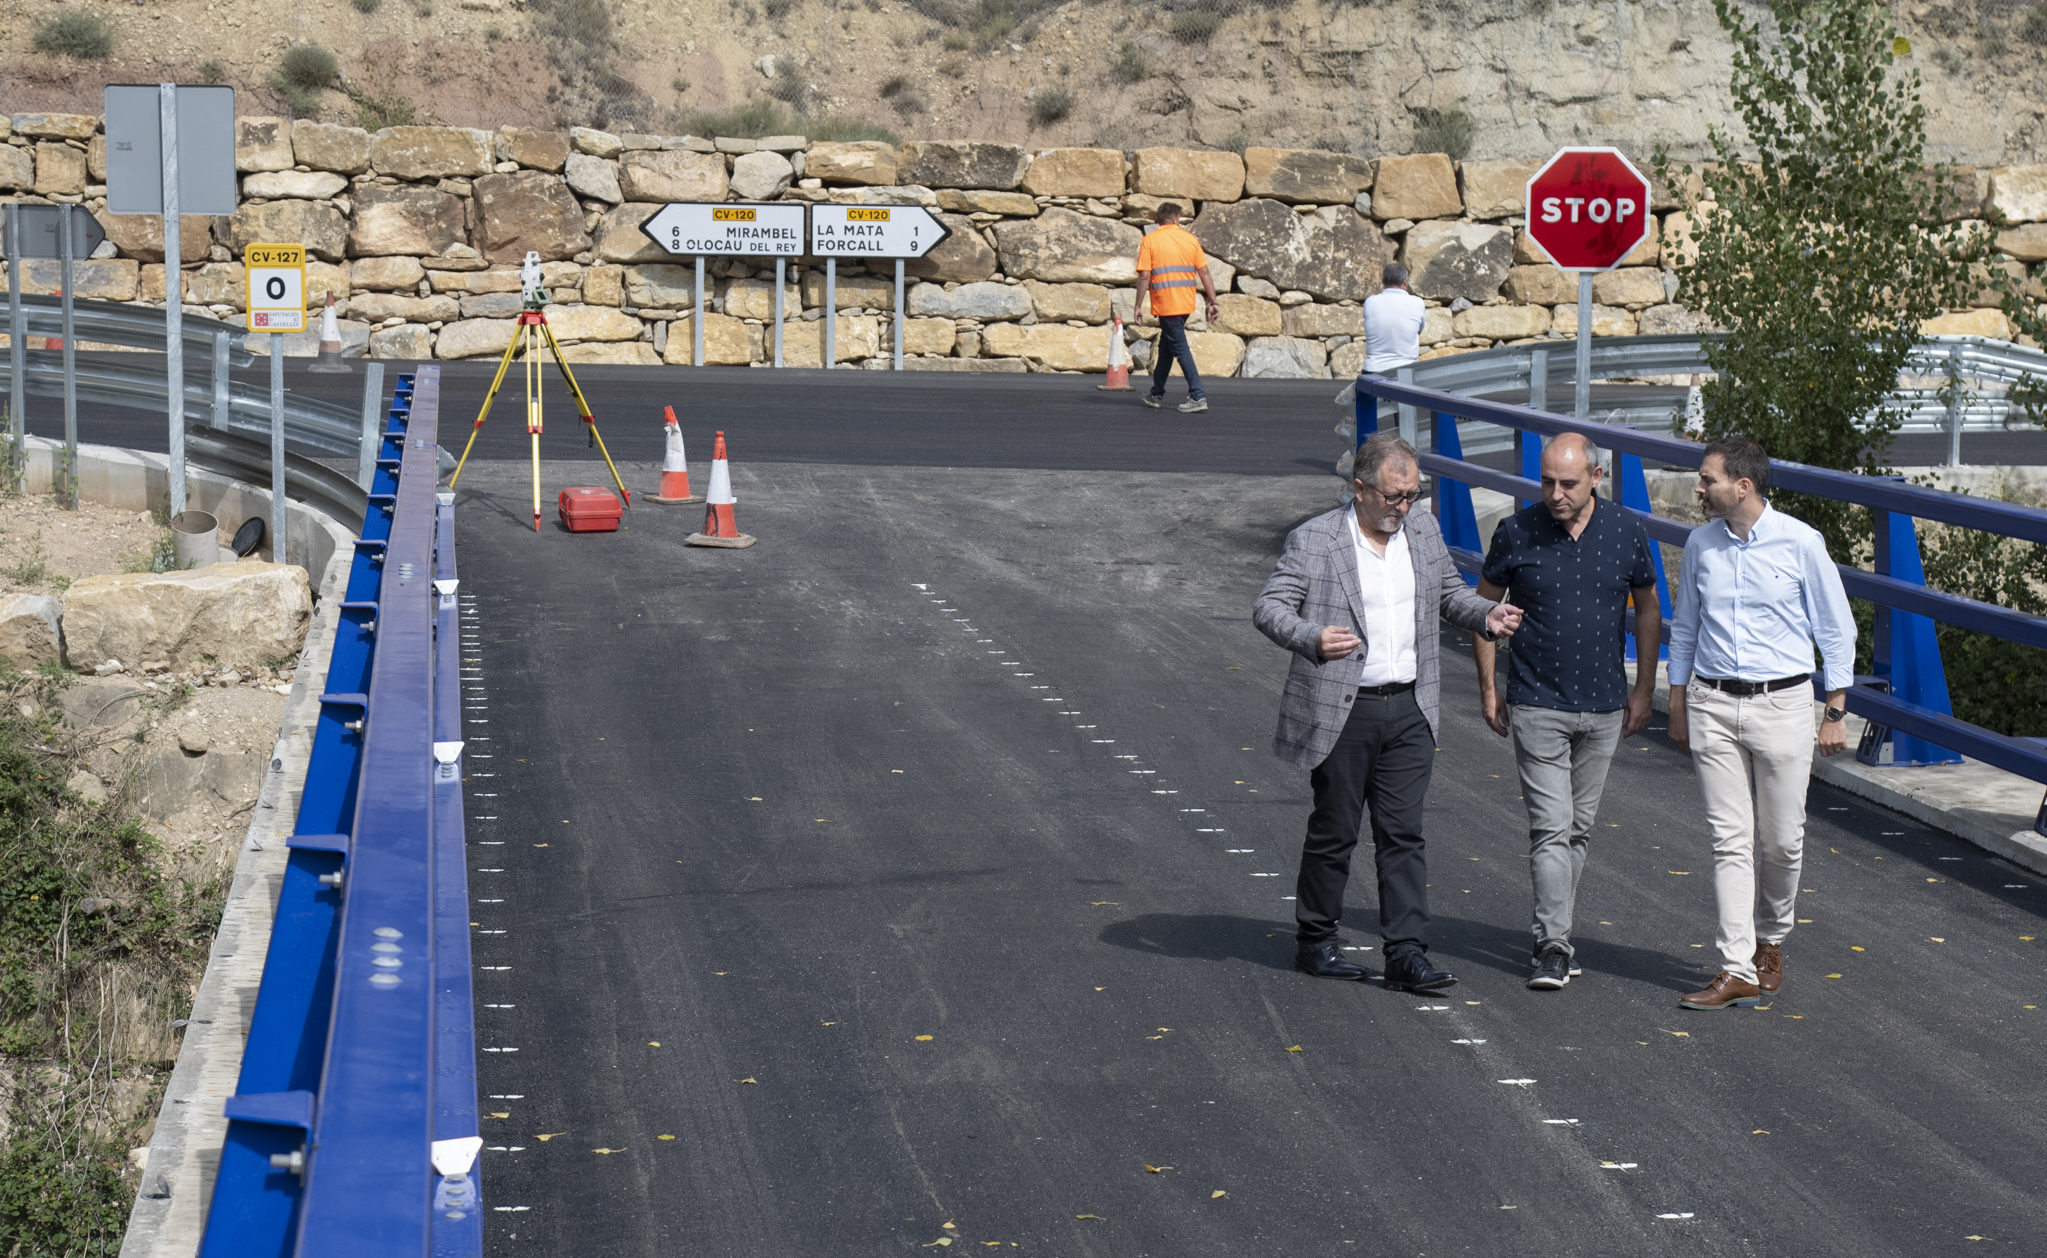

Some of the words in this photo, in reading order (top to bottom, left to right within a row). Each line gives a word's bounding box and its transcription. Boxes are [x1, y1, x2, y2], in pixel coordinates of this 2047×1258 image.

[714, 210, 754, 220] CV-120
[848, 210, 889, 220] CV-120
[1541, 197, 1636, 224] STOP
[672, 226, 680, 237] 6
[726, 227, 796, 239] MIRAMBEL
[817, 225, 834, 236] LA
[844, 225, 884, 236] MATA
[913, 226, 919, 237] 1
[672, 239, 680, 250] 8
[686, 240, 742, 251] OLOCAU
[750, 242, 770, 252] DEL
[776, 243, 796, 252] REY
[817, 240, 884, 251] FORCALL
[910, 241, 918, 251] 9
[251, 252, 299, 262] CV-127
